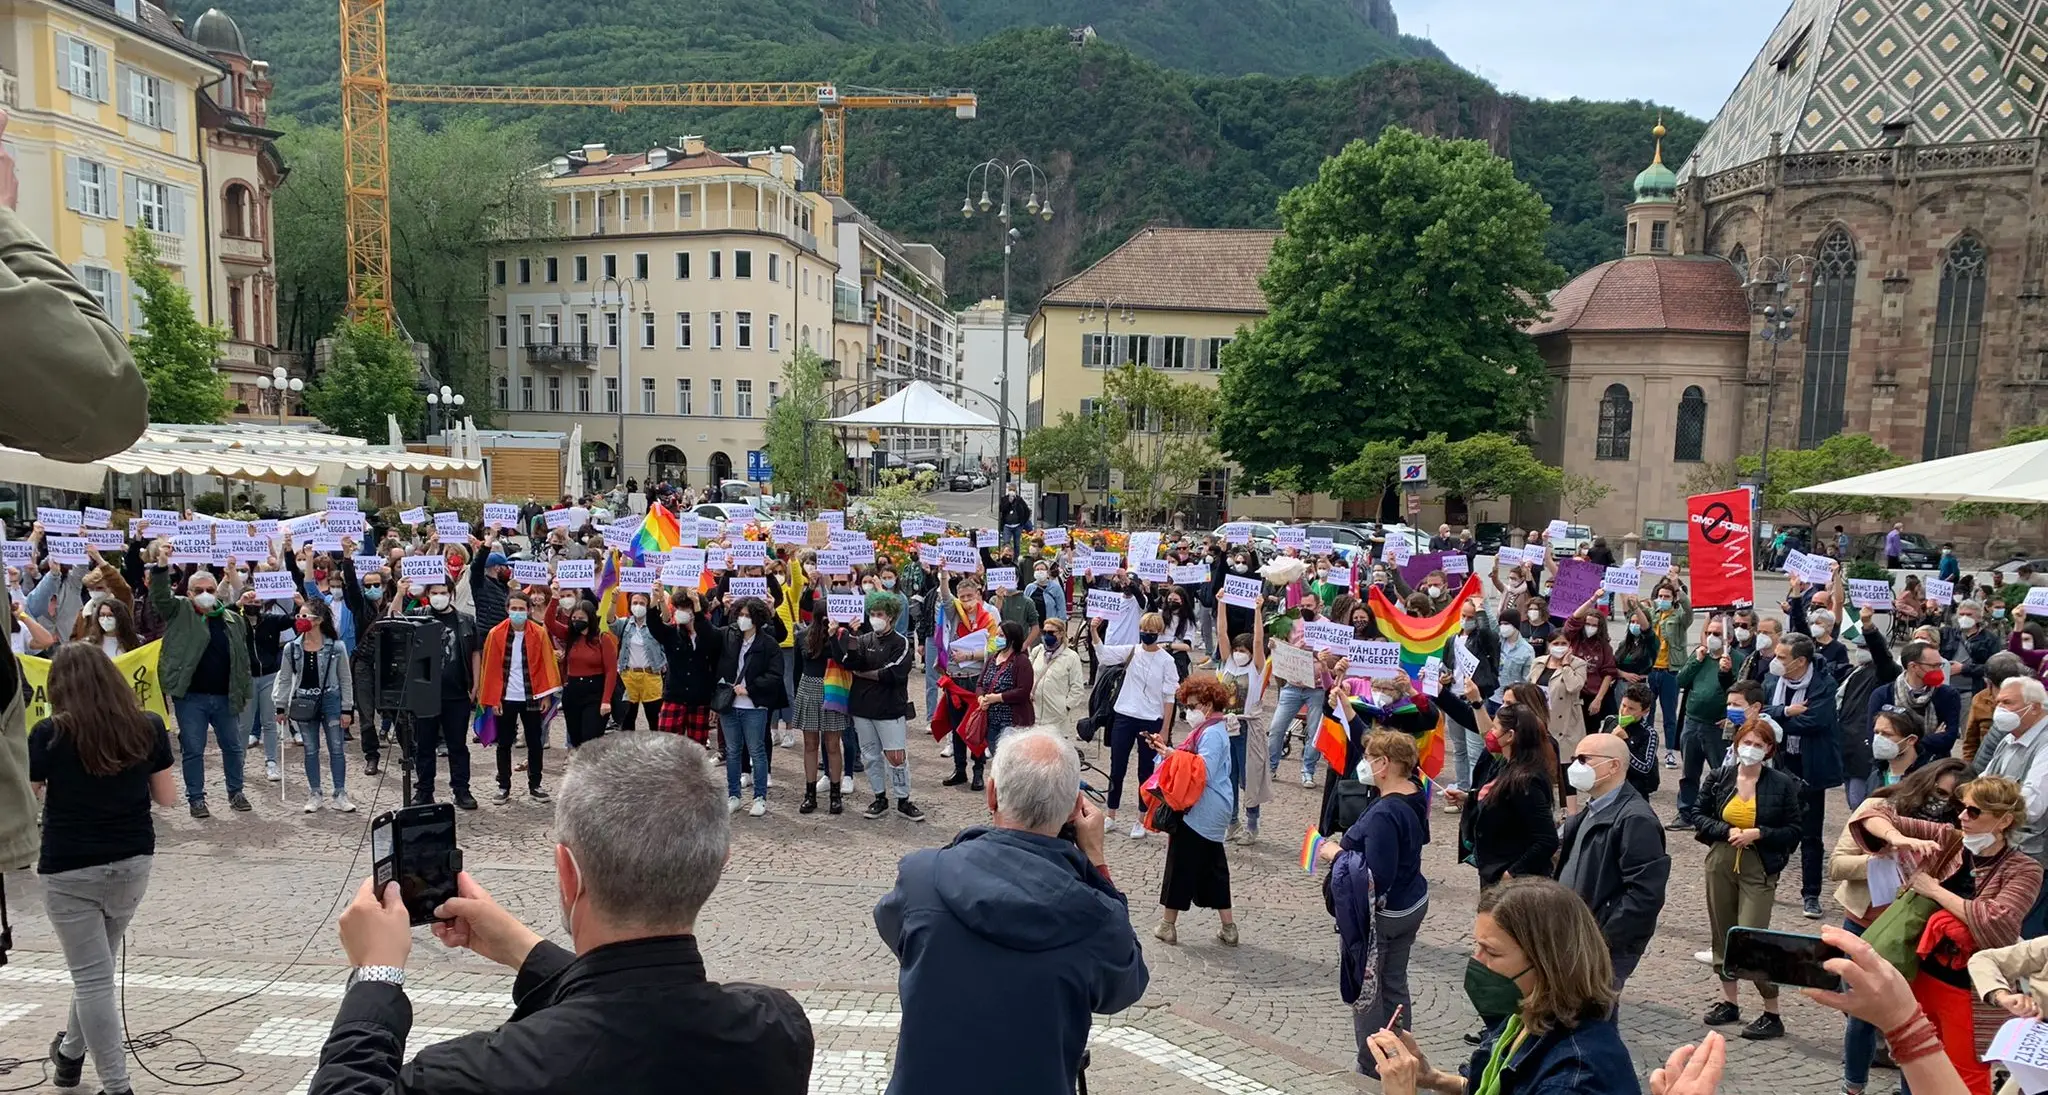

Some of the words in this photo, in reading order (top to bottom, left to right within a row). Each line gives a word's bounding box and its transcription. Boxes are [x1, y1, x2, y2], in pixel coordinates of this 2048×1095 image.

[944, 550, 965, 558] VOTATE
[963, 557, 975, 565] ZAN
[403, 567, 426, 575] LEGGE
[428, 567, 444, 575] ZAN
[1608, 571, 1630, 579] VOTATE
[255, 574, 278, 583] WÄHLT
[279, 575, 293, 583] DAS
[620, 576, 655, 584] ZAN-GESETZ
[1606, 578, 1625, 586] LEGGE
[1226, 579, 1249, 590] VOTATE
[1850, 584, 1871, 592] WÄHLT
[731, 588, 751, 596] LEGGE
[752, 588, 766, 596] ZAN
[1224, 586, 1245, 596] LEGGE
[1245, 590, 1259, 599] ZAN
[1850, 591, 1890, 600] ZAN-GESETZ
[828, 598, 852, 606] VOTATE
[1089, 593, 1107, 602] WÄHLT
[1108, 596, 1121, 604] DAS
[828, 605, 848, 613] LEGGE
[849, 606, 863, 614] ZAN
[1088, 601, 1121, 611] ZAN-GESETZ
[1316, 626, 1338, 638] WÄHLT
[1339, 630, 1353, 639] DAS
[1349, 643, 1380, 654] WÄHLT
[1381, 647, 1400, 657] DAS
[1348, 654, 1399, 666] ZAN-GESETZ
